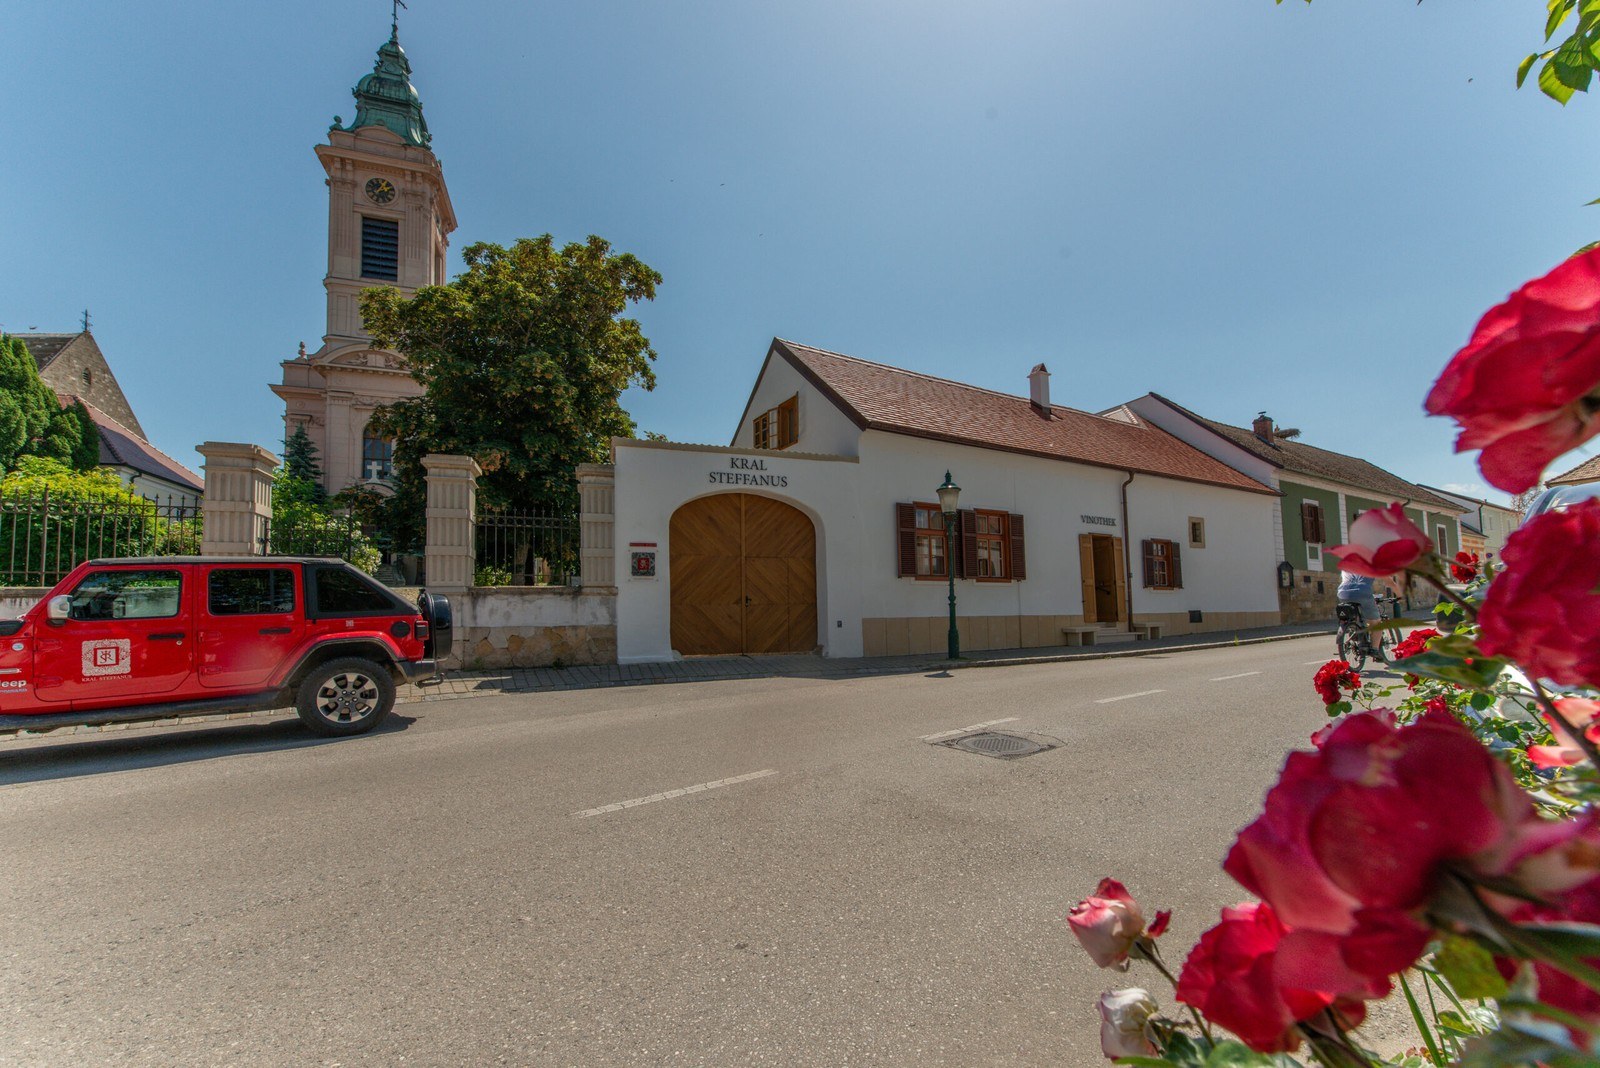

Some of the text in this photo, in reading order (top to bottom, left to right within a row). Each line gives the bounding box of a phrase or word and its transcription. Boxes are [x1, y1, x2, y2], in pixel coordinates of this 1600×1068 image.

[730, 457, 768, 471] KRAL
[709, 471, 788, 488] STEFFANUS
[1080, 514, 1117, 527] VINOTHEK
[0, 679, 27, 688] eep
